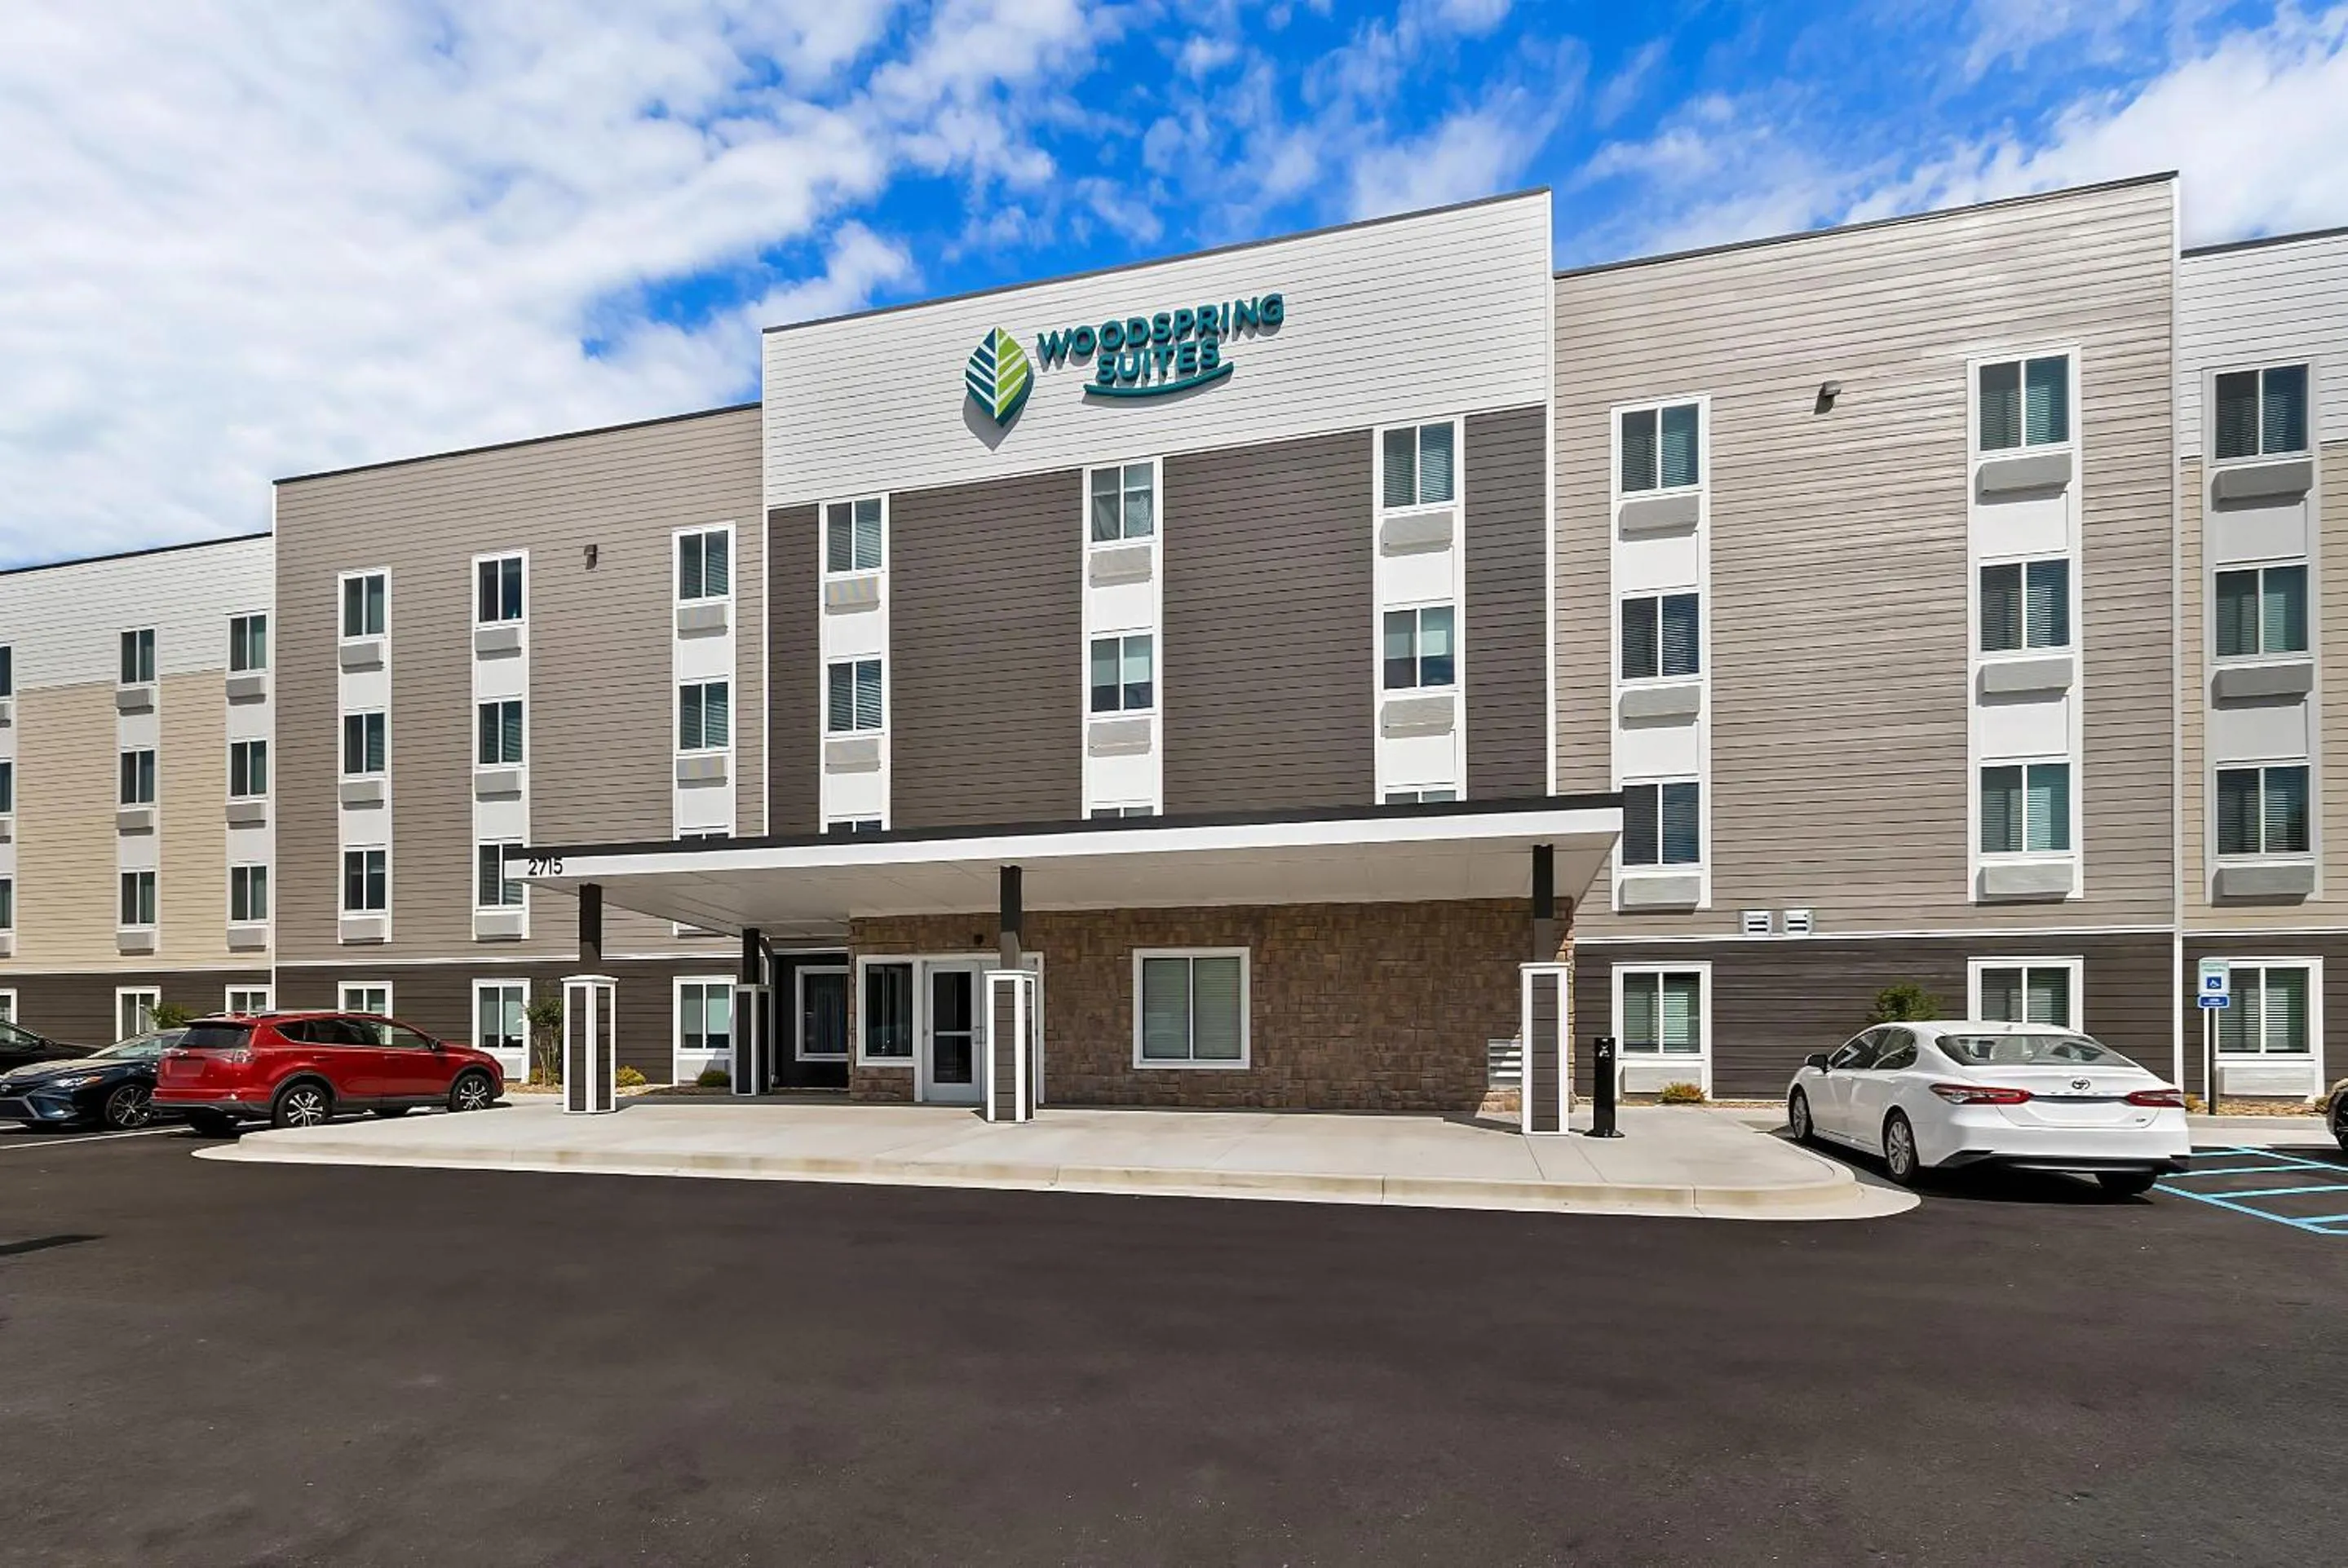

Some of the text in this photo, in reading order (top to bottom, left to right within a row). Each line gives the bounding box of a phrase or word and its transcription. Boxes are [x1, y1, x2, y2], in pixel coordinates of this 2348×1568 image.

[1037, 294, 1285, 366] WOODSPRING
[1097, 338, 1220, 385] SUITES
[528, 858, 563, 876] 2715
